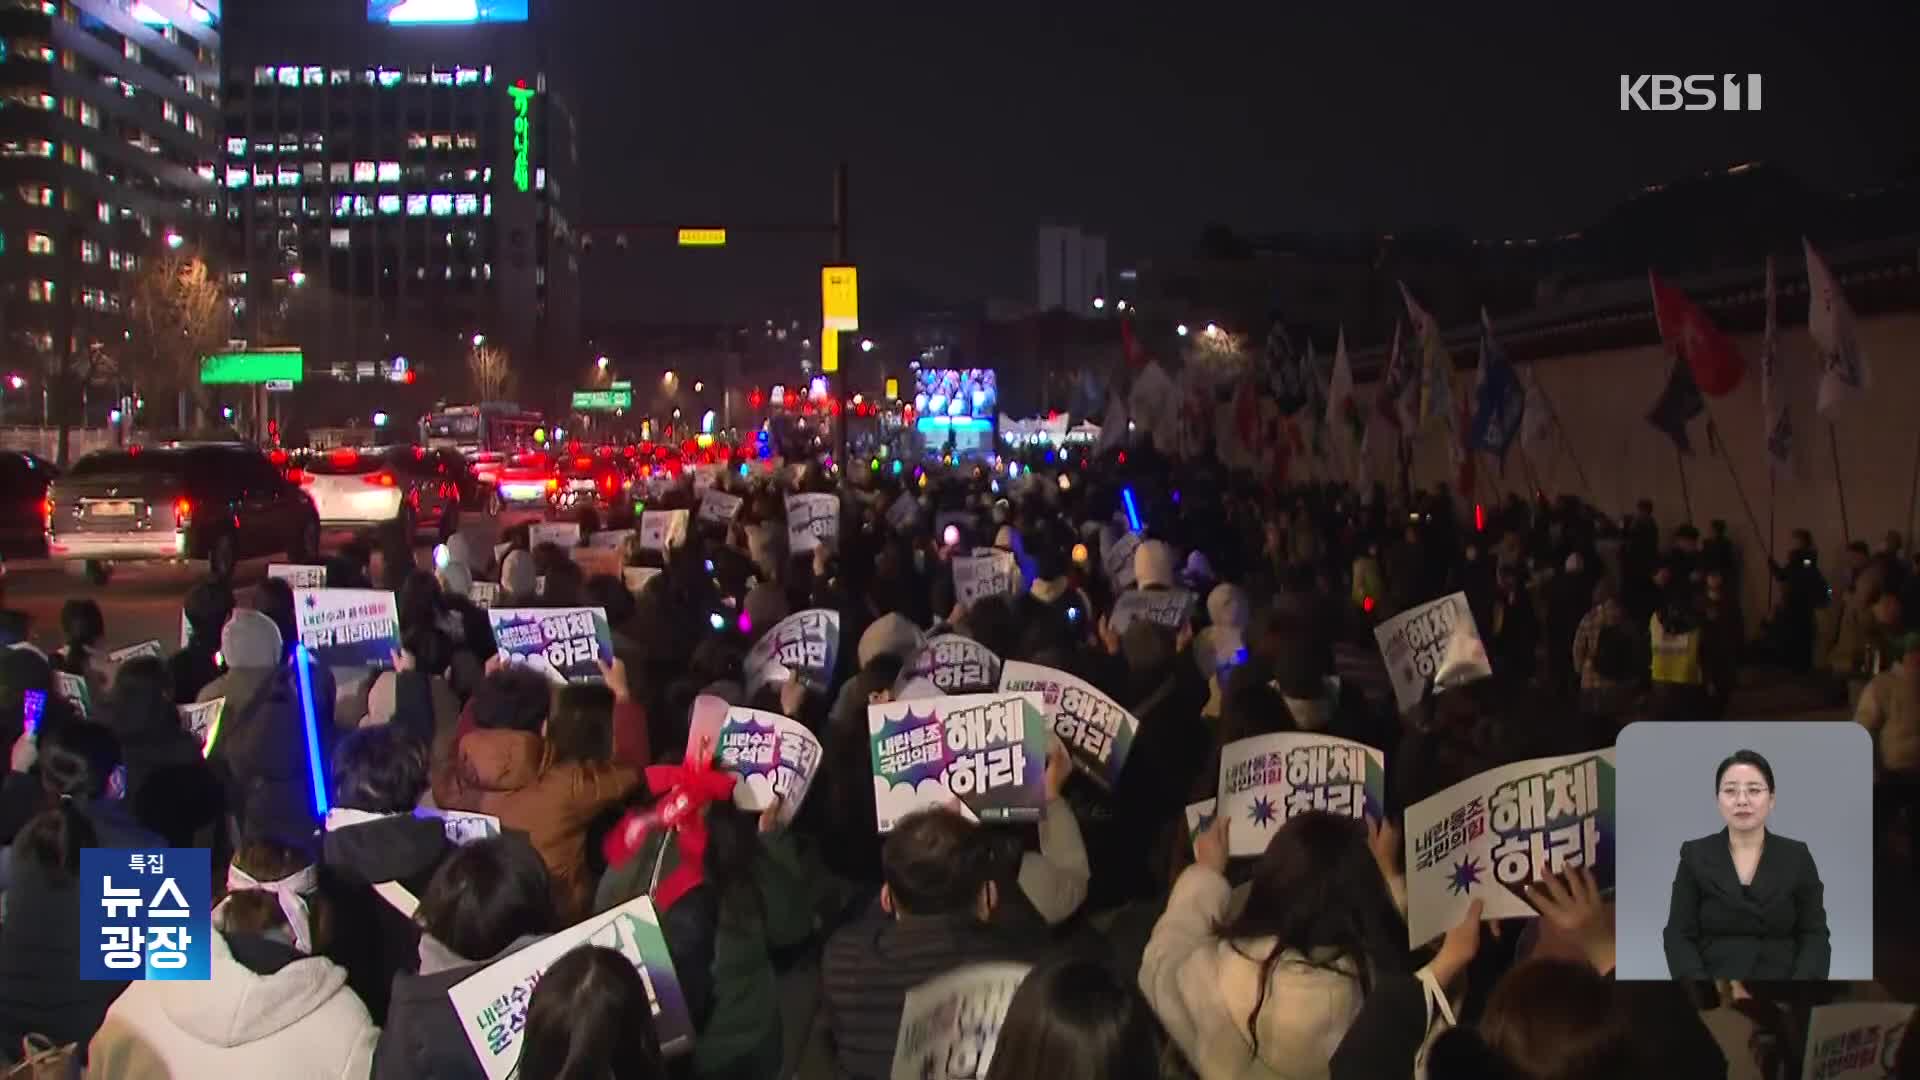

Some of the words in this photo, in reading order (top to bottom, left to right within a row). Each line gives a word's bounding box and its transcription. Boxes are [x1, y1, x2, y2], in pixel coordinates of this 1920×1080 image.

[543, 610, 596, 640] 해체
[546, 636, 600, 667] 하라
[935, 641, 990, 664] 해체
[933, 662, 991, 688] 하라
[944, 698, 1026, 752] 해체
[1061, 686, 1124, 737] 해체
[877, 722, 943, 757] 내란동조
[879, 741, 943, 775] 국민의힘
[1054, 712, 1114, 764] 하라
[948, 743, 1027, 796] 하라
[1224, 766, 1282, 795] 국민의힘
[1225, 751, 1282, 784] 내란동조
[1286, 744, 1367, 787] 해체
[1488, 756, 1600, 833] 해체
[1414, 795, 1485, 852] 내란동조
[1415, 815, 1485, 872] 국민의힘
[1490, 814, 1602, 885] 하라
